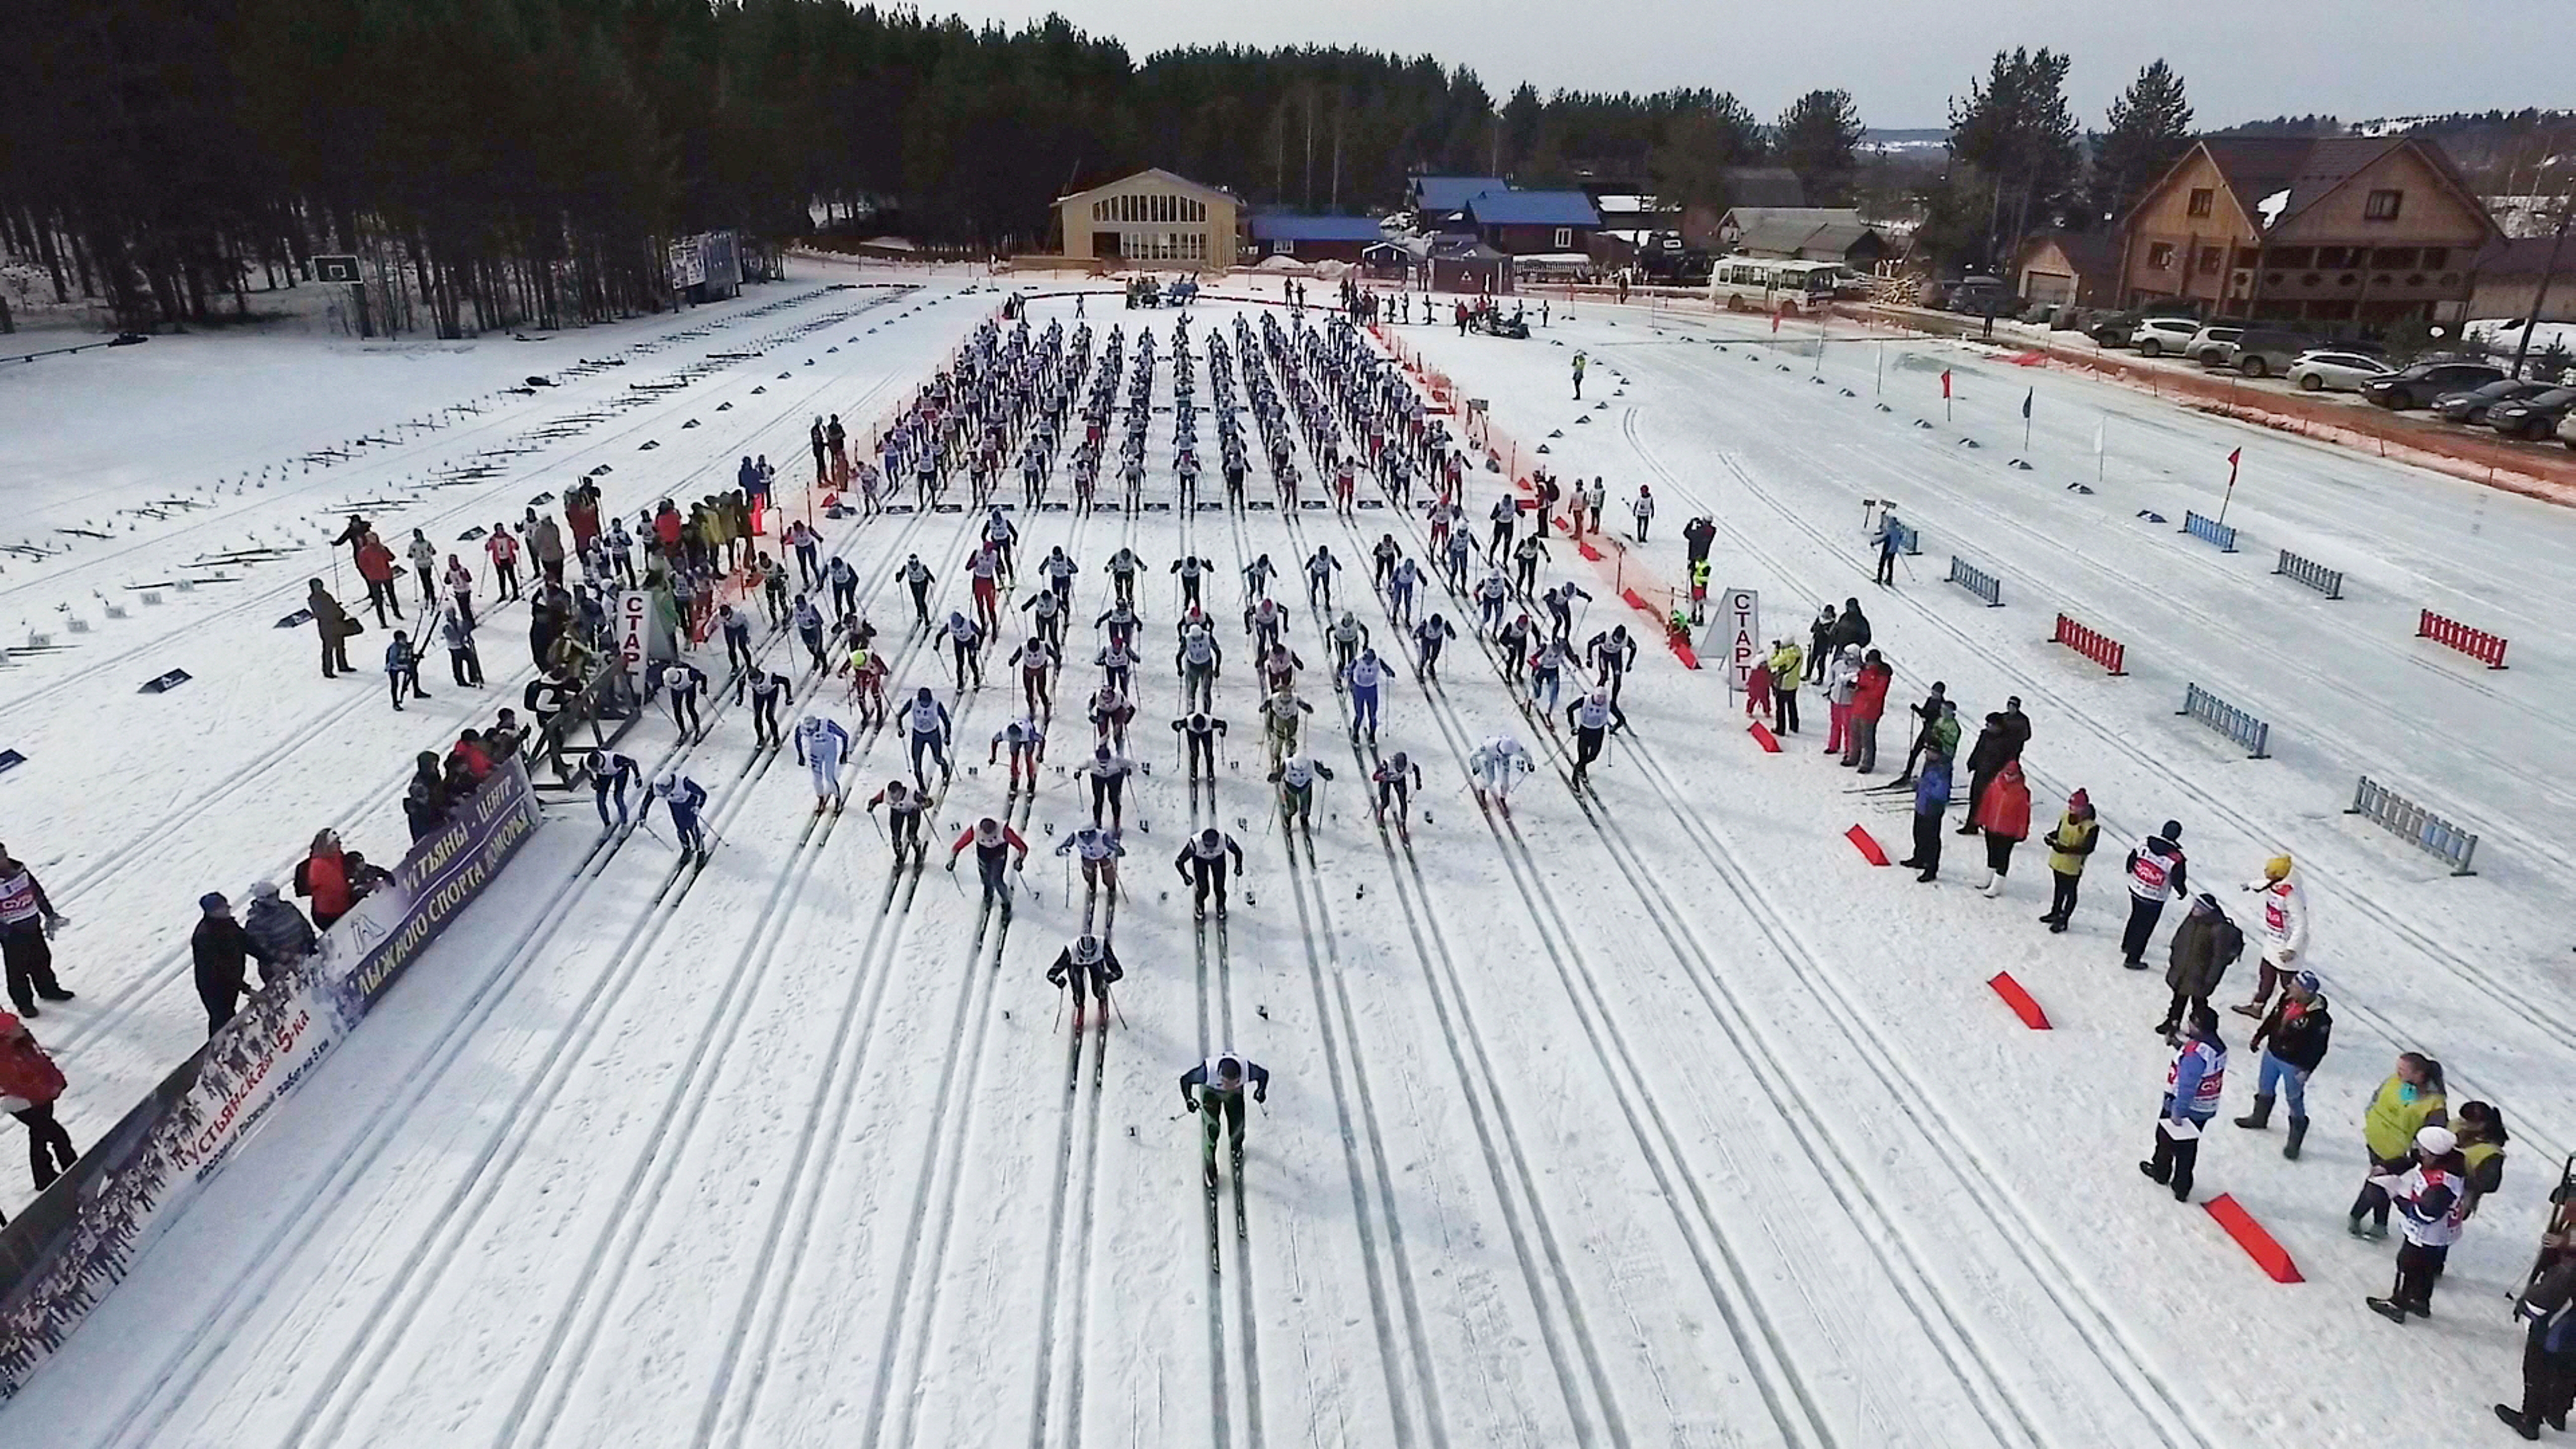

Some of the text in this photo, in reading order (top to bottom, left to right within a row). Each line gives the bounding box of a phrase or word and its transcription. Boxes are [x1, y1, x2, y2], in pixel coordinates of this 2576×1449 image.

[1734, 594, 1751, 681] СТАРТ
[476, 775, 511, 824] ЦЕНТР
[357, 912, 428, 1002] ЛЫЖНОГО
[428, 861, 485, 922] СПОРТА
[1129, 1127, 1136, 1137] 1
